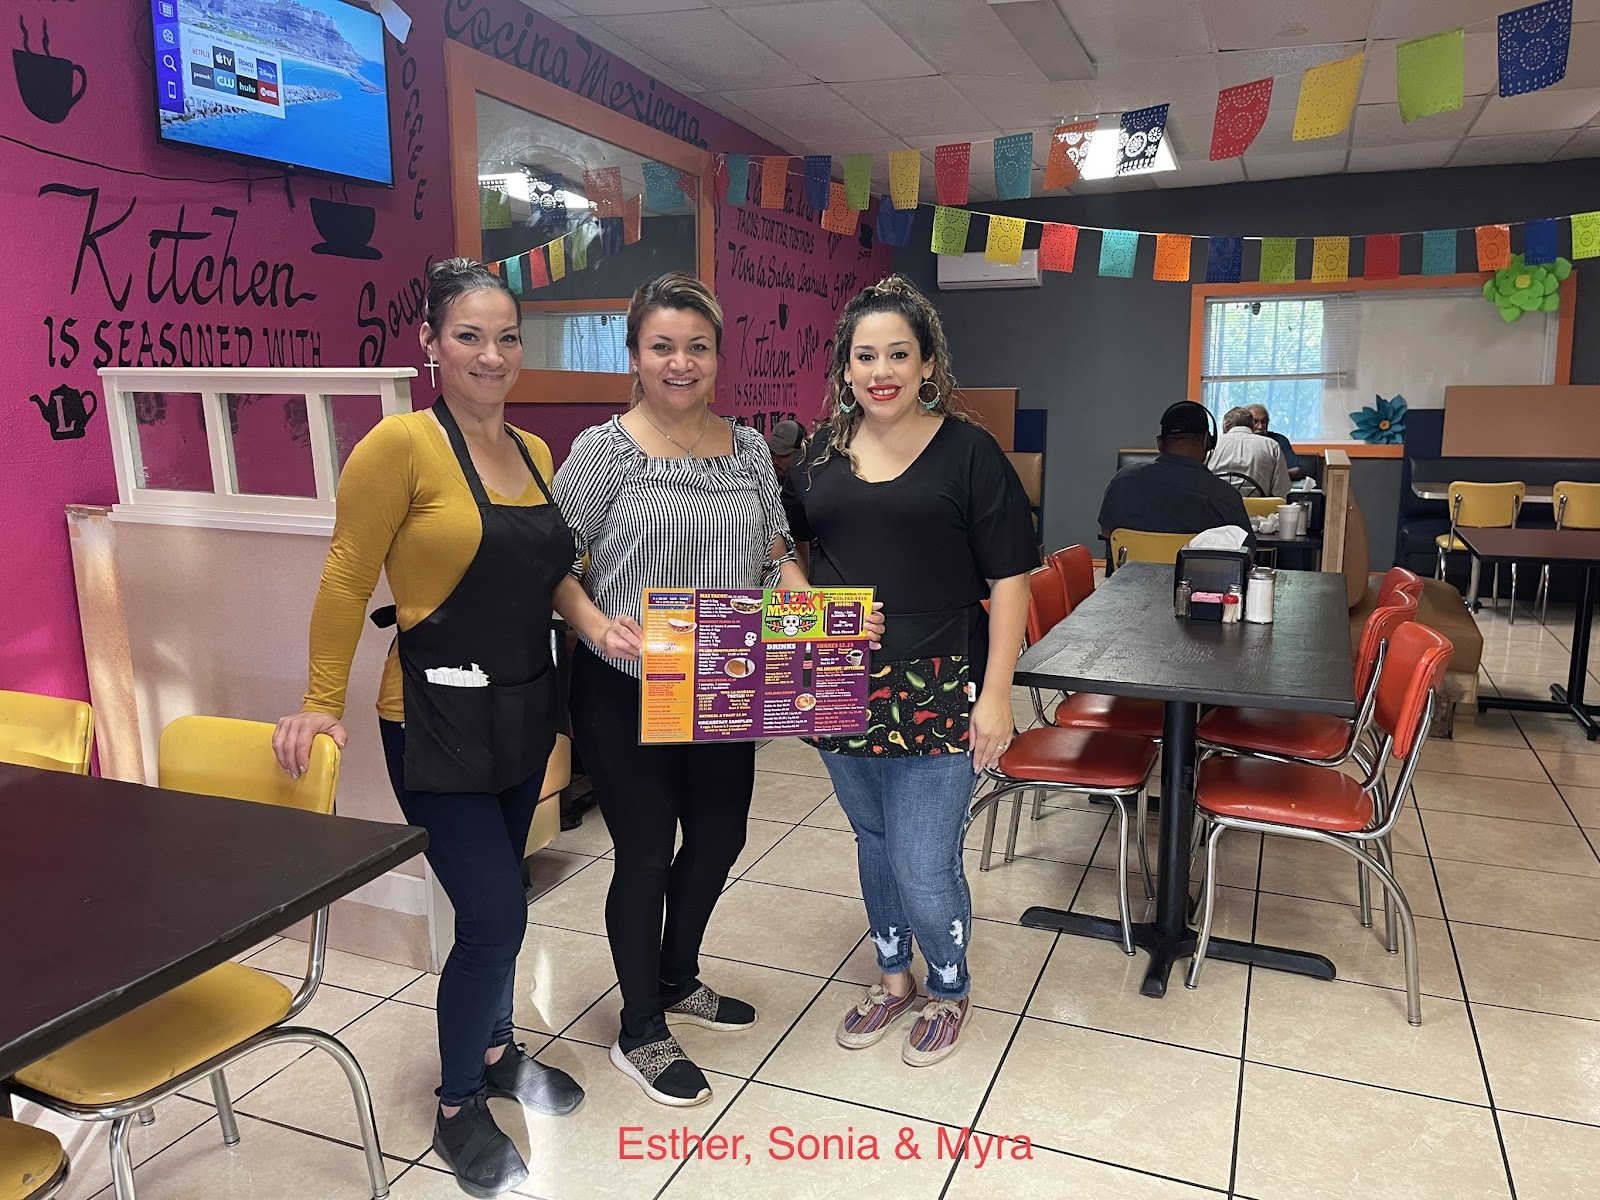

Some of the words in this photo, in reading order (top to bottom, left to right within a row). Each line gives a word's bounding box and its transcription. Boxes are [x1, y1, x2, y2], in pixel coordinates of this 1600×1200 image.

[192, 48, 210, 58] NETFLIX
[217, 76, 235, 89] CW
[239, 82, 256, 94] hulu
[444, 0, 570, 89] Cocina
[576, 34, 709, 149] Mexicana
[38, 183, 317, 311] Kitchen
[768, 255, 795, 289] Salsa
[43, 315, 80, 369] IS
[92, 319, 253, 367] SEASONED
[262, 326, 322, 367] WITH
[736, 315, 796, 378] Kitchen
[744, 382, 780, 407] SEASONED
[54, 394, 76, 432] L
